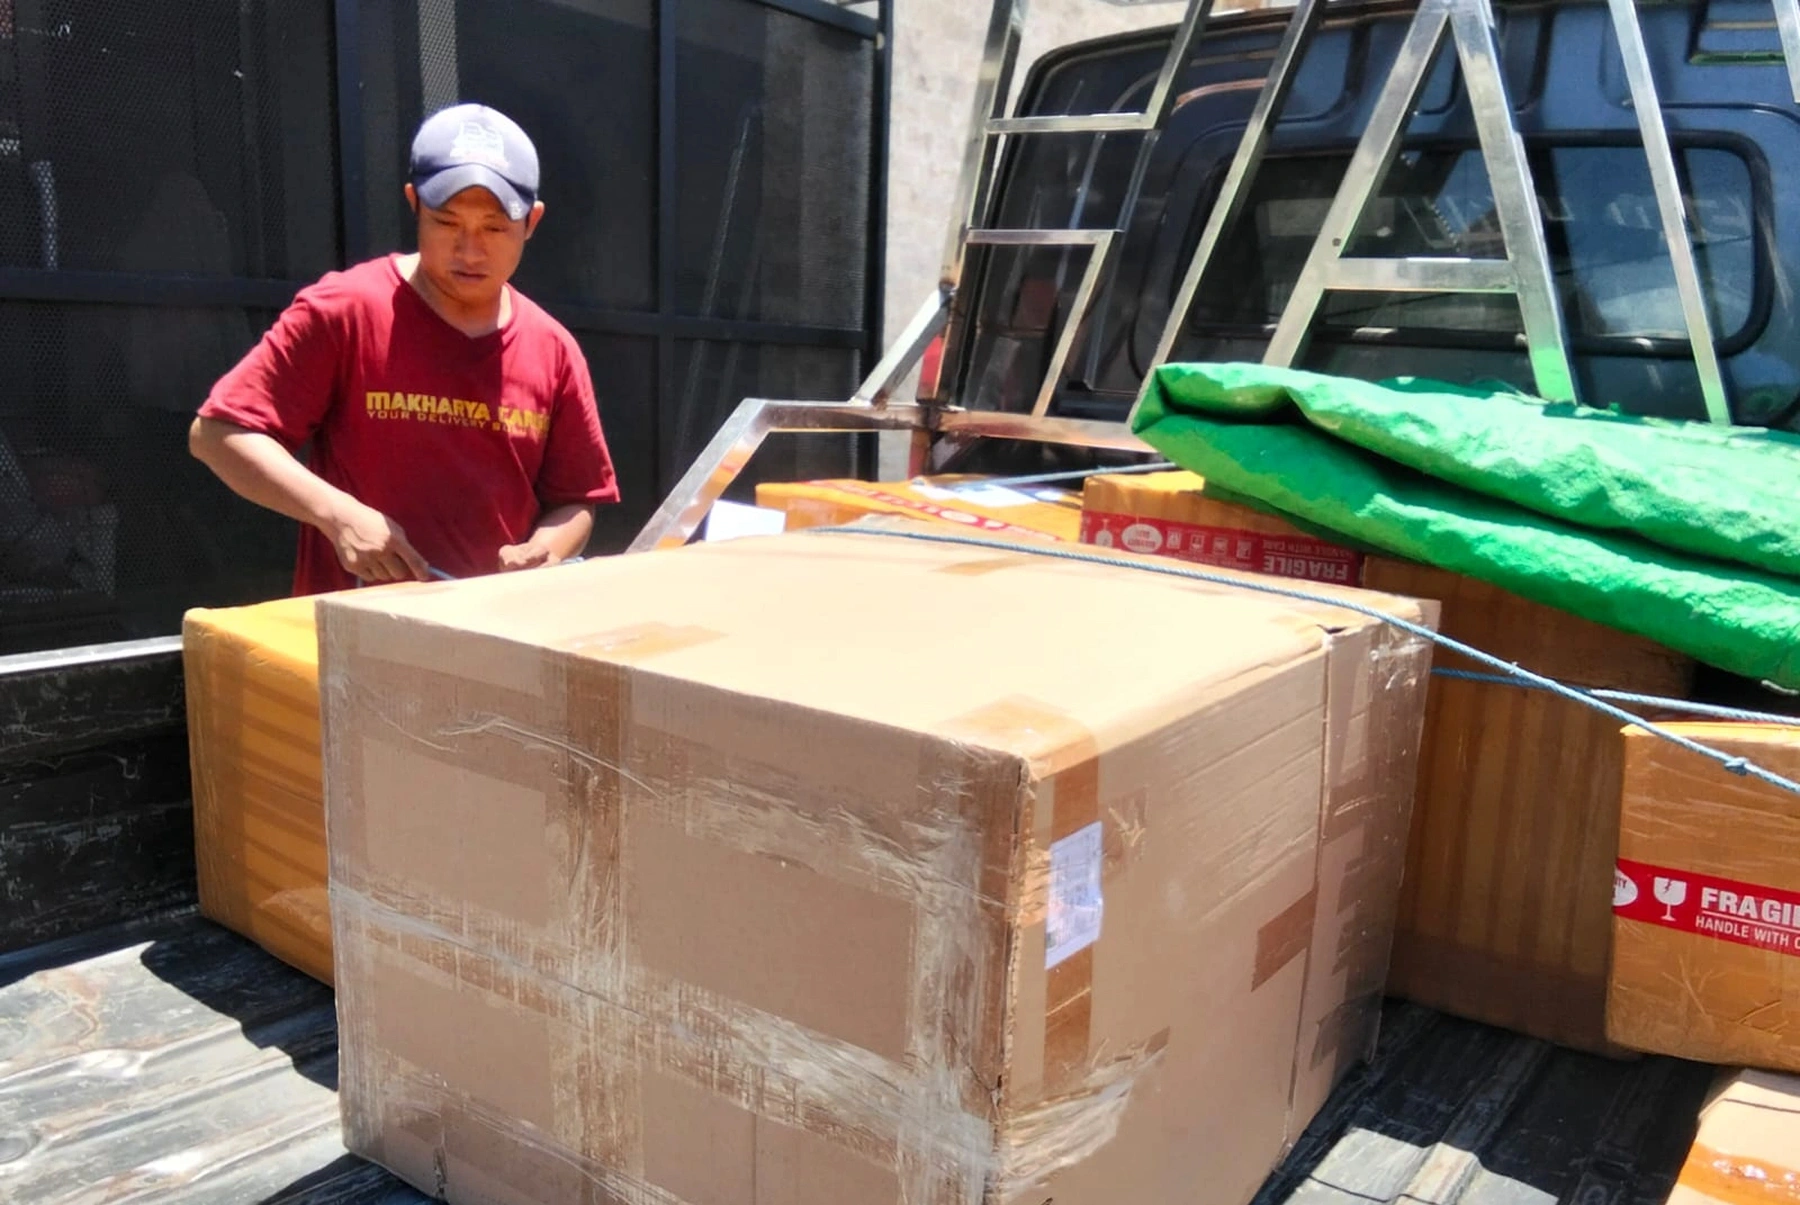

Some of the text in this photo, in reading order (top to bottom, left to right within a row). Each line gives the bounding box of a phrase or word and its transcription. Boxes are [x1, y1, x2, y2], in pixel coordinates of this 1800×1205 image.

[366, 391, 490, 421] MAKHARYA
[498, 406, 550, 432] CAR
[367, 410, 487, 428] YOUR DELIVERY
[1263, 555, 1348, 581] FRAGILE
[1695, 915, 1749, 938] HANDLE
[1754, 927, 1789, 947] WITH
